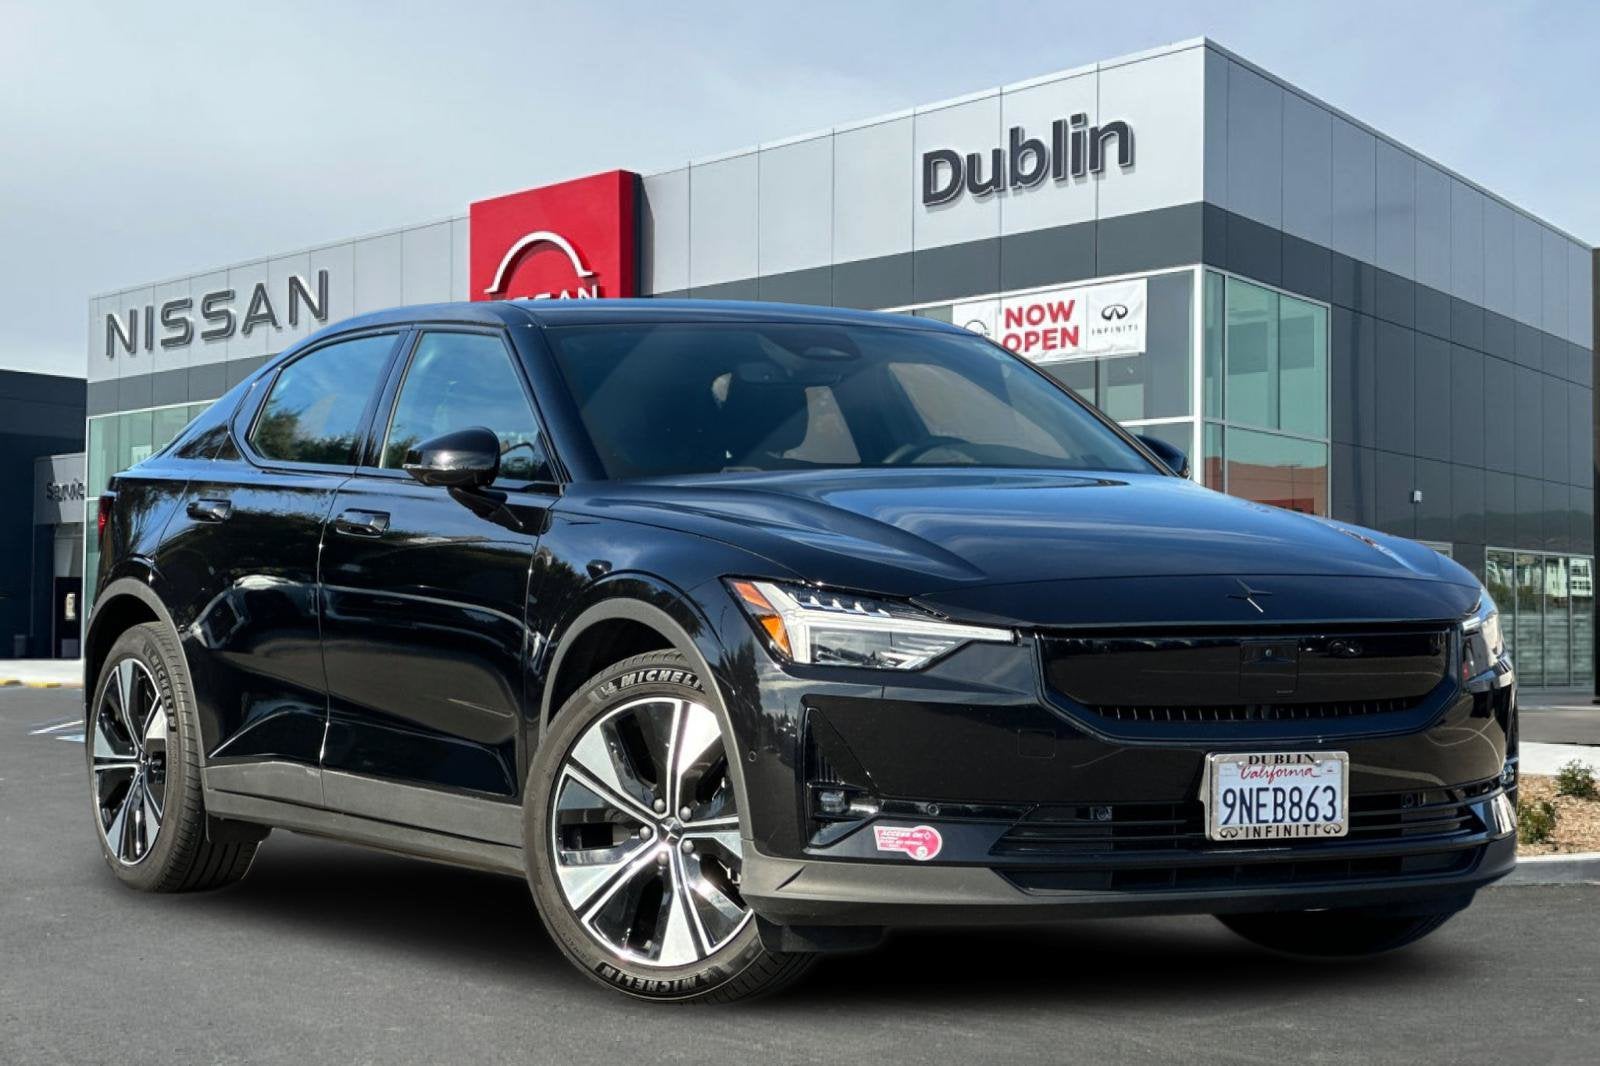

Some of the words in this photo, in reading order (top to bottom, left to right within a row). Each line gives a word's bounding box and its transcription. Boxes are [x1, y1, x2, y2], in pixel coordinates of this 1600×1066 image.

[922, 112, 1136, 207] Dublin
[105, 269, 329, 360] NISSAN
[1005, 299, 1076, 329] NOW
[1002, 325, 1080, 353] OPEN
[620, 669, 705, 691] MICHELI
[1248, 753, 1316, 765] DUBLIN
[1240, 764, 1322, 784] California
[1221, 785, 1337, 825] 9NEB863
[1245, 824, 1319, 838] INFINITI
[601, 966, 698, 993] MICHELIN
